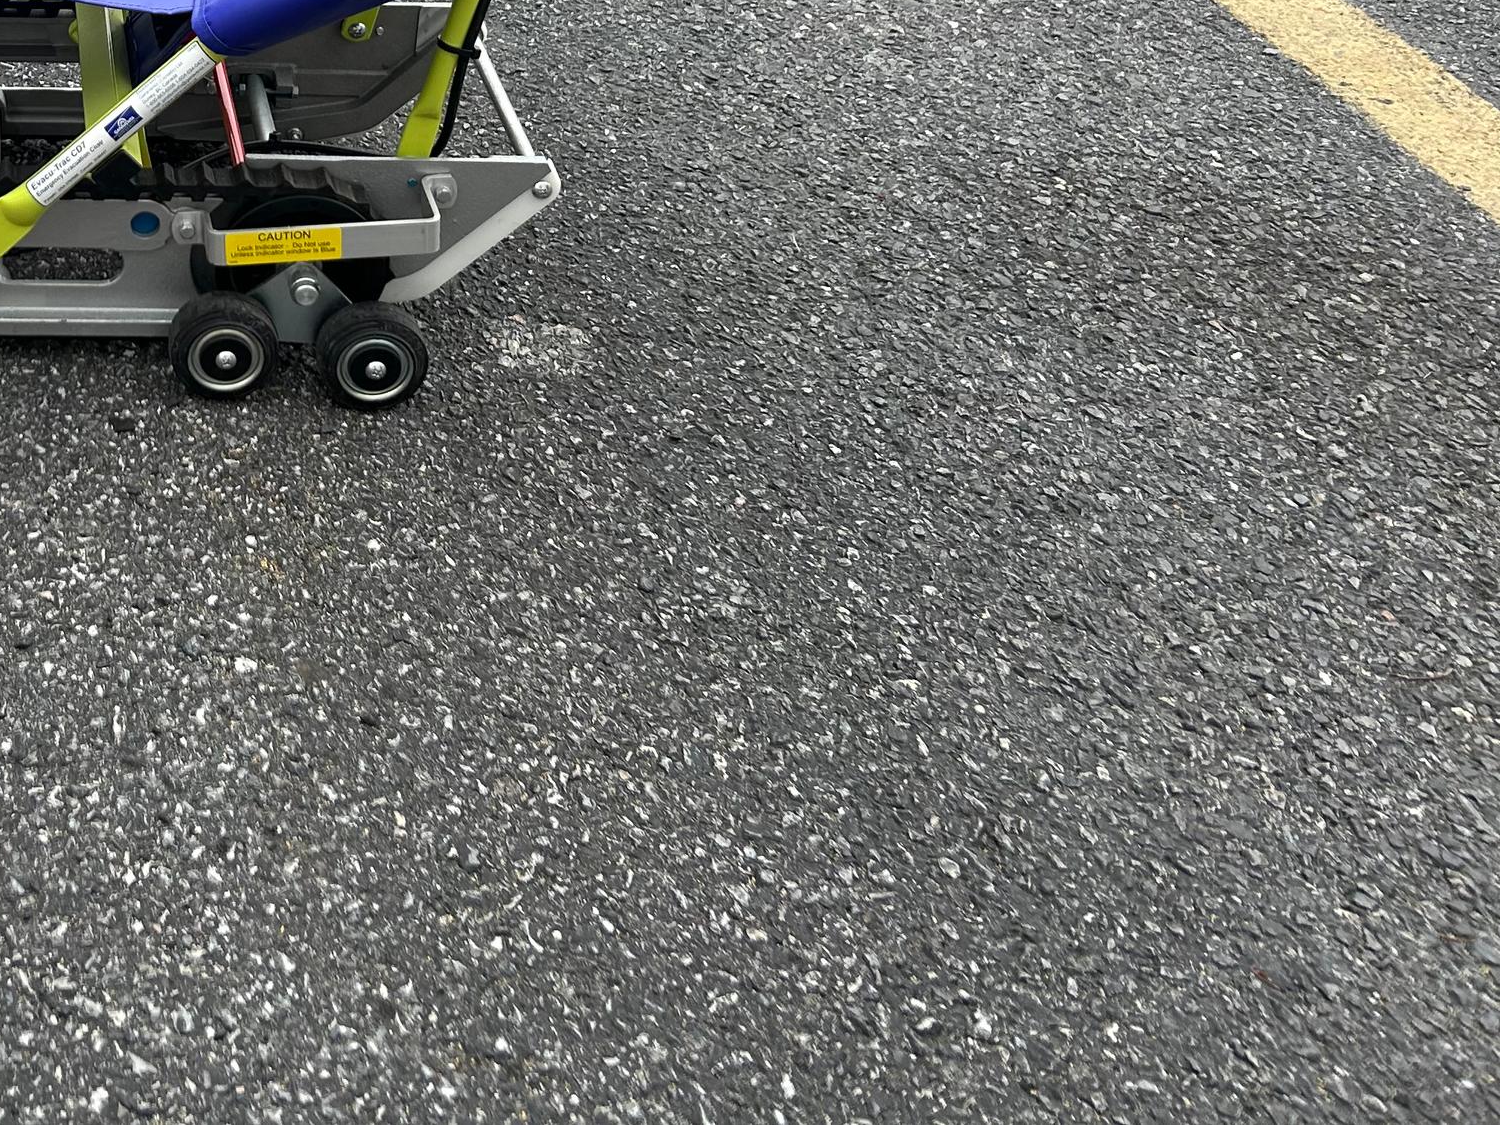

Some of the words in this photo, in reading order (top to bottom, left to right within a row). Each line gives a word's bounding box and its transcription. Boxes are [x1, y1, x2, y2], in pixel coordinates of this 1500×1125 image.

[30, 155, 71, 190] Evacu-Trac
[70, 140, 87, 158] CD7
[35, 172, 64, 197] Emergency
[62, 150, 91, 174] Evacuation
[258, 230, 311, 241] CAUTION
